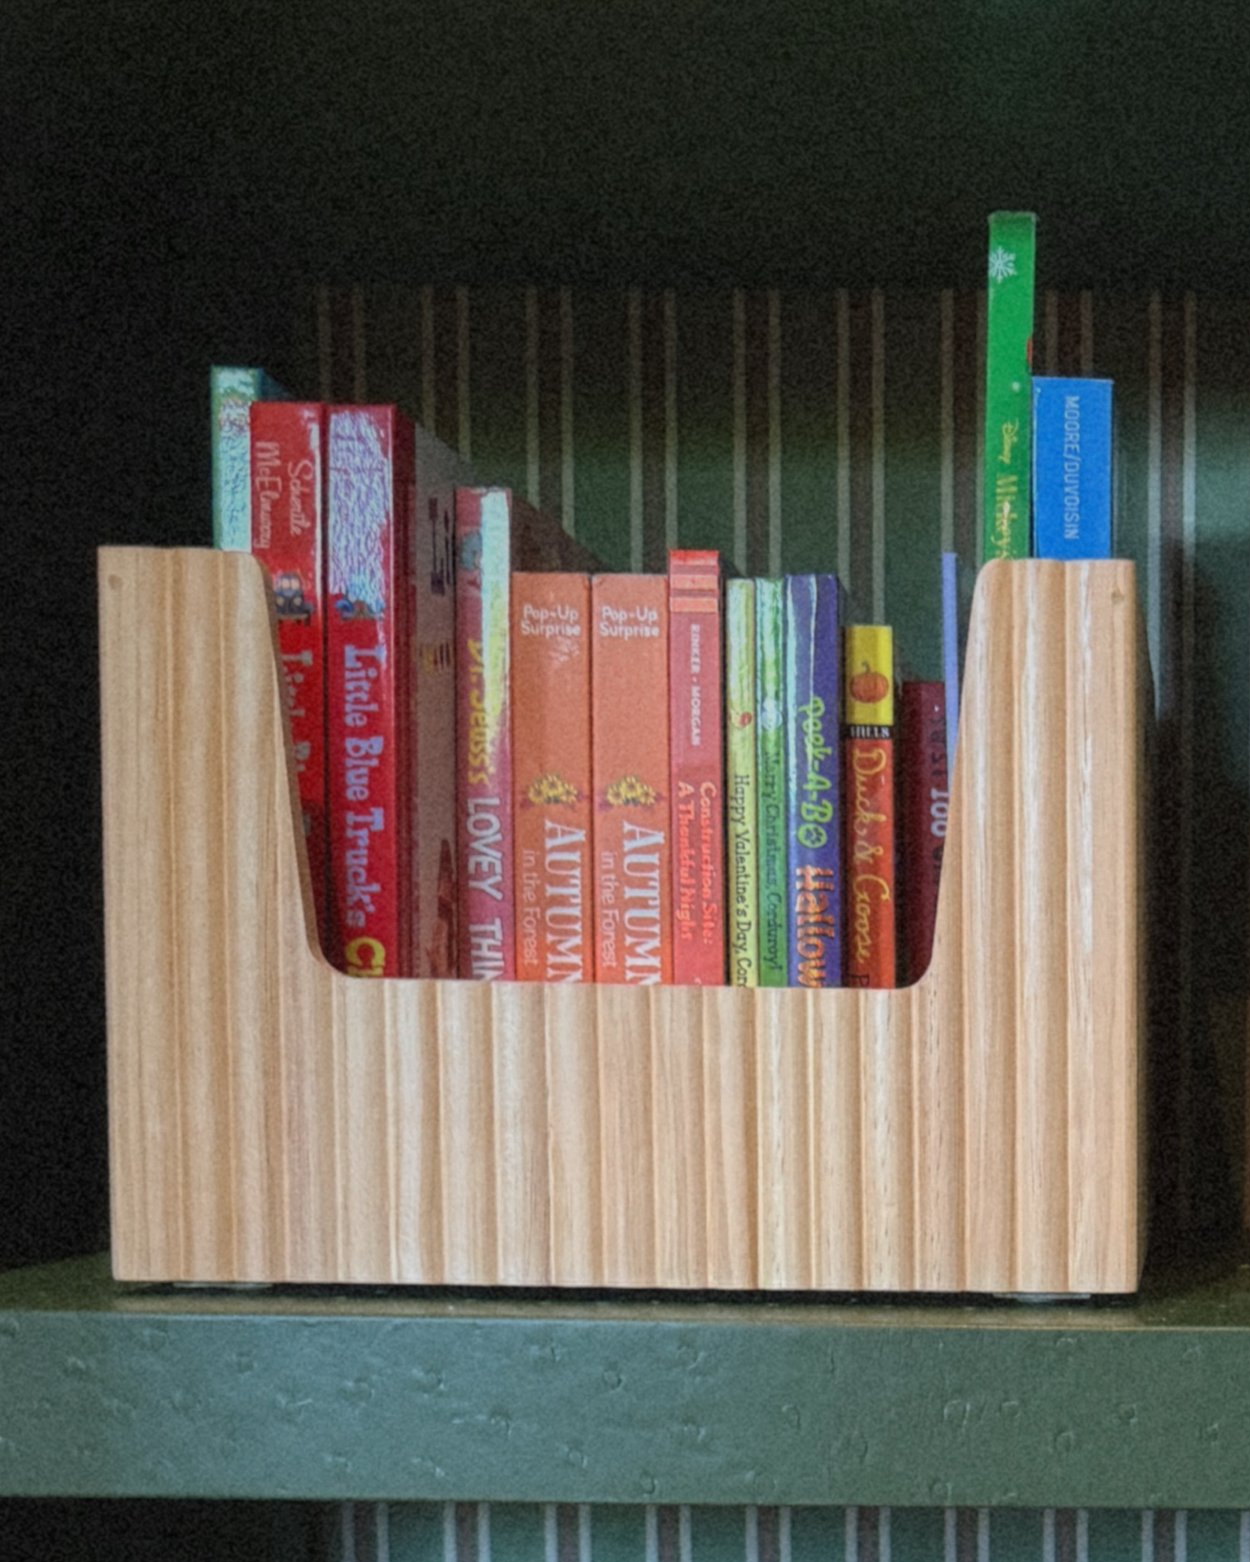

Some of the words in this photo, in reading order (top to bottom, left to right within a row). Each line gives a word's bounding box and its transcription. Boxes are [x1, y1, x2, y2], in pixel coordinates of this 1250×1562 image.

[1063, 395, 1081, 539] MOORE/DUVOISIN
[520, 620, 582, 638] Surprise
[523, 603, 580, 623] Pop-Up
[599, 621, 661, 640] Surprise
[602, 605, 659, 625] Pop-Up
[345, 644, 386, 727] Little
[345, 736, 383, 801] Blue
[680, 782, 694, 797] A
[853, 748, 886, 837] Duck
[732, 775, 749, 824] Happy
[345, 807, 384, 928] Truck's
[467, 798, 501, 900] LOVEY
[523, 850, 539, 867] in
[602, 851, 618, 868] in
[523, 872, 540, 903] the
[601, 874, 618, 904] the
[734, 832, 748, 917] Valentine's
[523, 908, 539, 965] Forest
[602, 910, 618, 967] Forest
[733, 922, 750, 953] Day,
[854, 874, 889, 964] Goose
